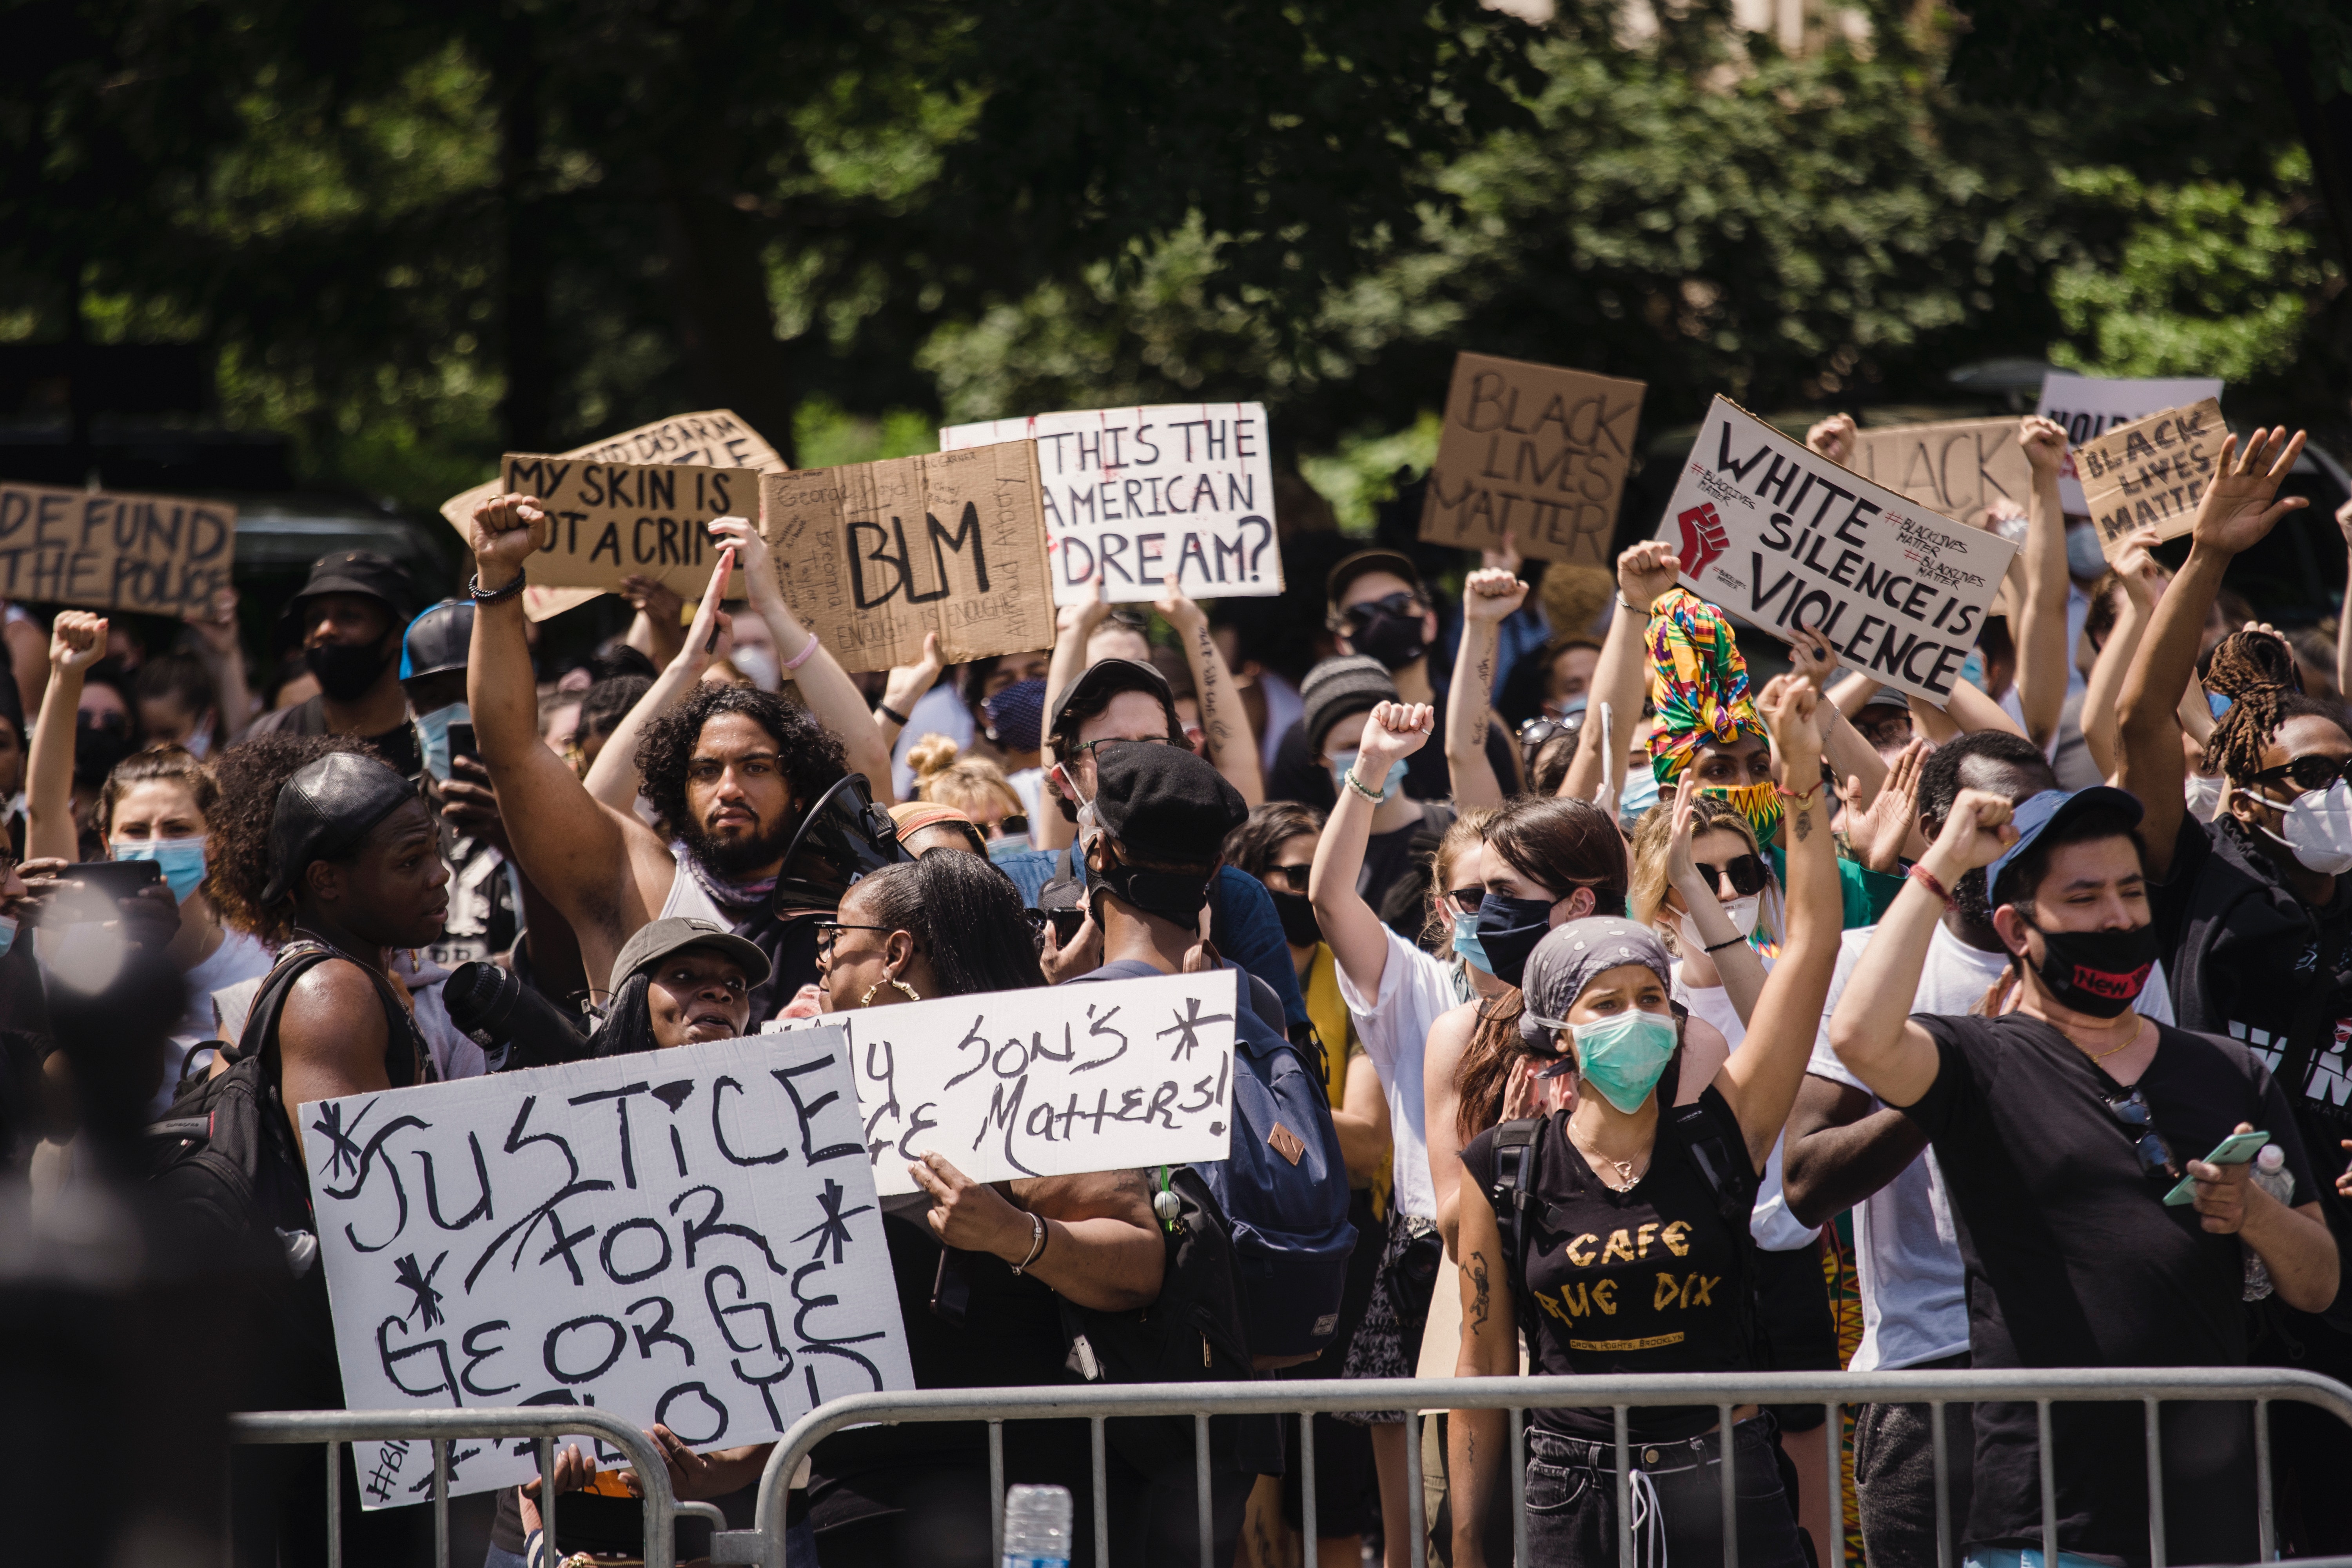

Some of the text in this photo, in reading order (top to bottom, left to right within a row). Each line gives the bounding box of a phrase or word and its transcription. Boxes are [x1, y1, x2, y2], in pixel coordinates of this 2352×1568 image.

[1455, 368, 1638, 457] BLACK
[2086, 410, 2211, 480] BLACK
[1038, 419, 1257, 474] THIS THE
[1481, 436, 1613, 503] LIVES
[1848, 428, 2018, 509] LACK
[2118, 444, 2212, 497] LIVES
[509, 459, 731, 515] MY SKIN IS
[1043, 473, 1254, 527] AMERICAN
[1697, 477, 1731, 508] MATTER
[1717, 421, 1883, 549] WHITE
[2101, 473, 2213, 541] MATTE
[0, 490, 229, 561] DEFUND
[539, 510, 588, 554] OT
[591, 521, 621, 566] A
[1062, 515, 1272, 586] DREAM?
[1425, 476, 1610, 565] MATTER
[1895, 531, 1941, 558] MATTER
[0, 549, 100, 599] THE
[846, 501, 990, 610] BLM
[1759, 512, 1982, 635] SILENCE IS
[1915, 567, 1960, 591] MATTER
[1751, 551, 1968, 696] VIOLENCE
[2078, 969, 2128, 997] New
[465, 1179, 787, 1295] FOR
[1566, 1221, 1693, 1267] CAFE
[375, 1259, 886, 1408] GEORGE
[1534, 1272, 1722, 1328] RUE DIX
